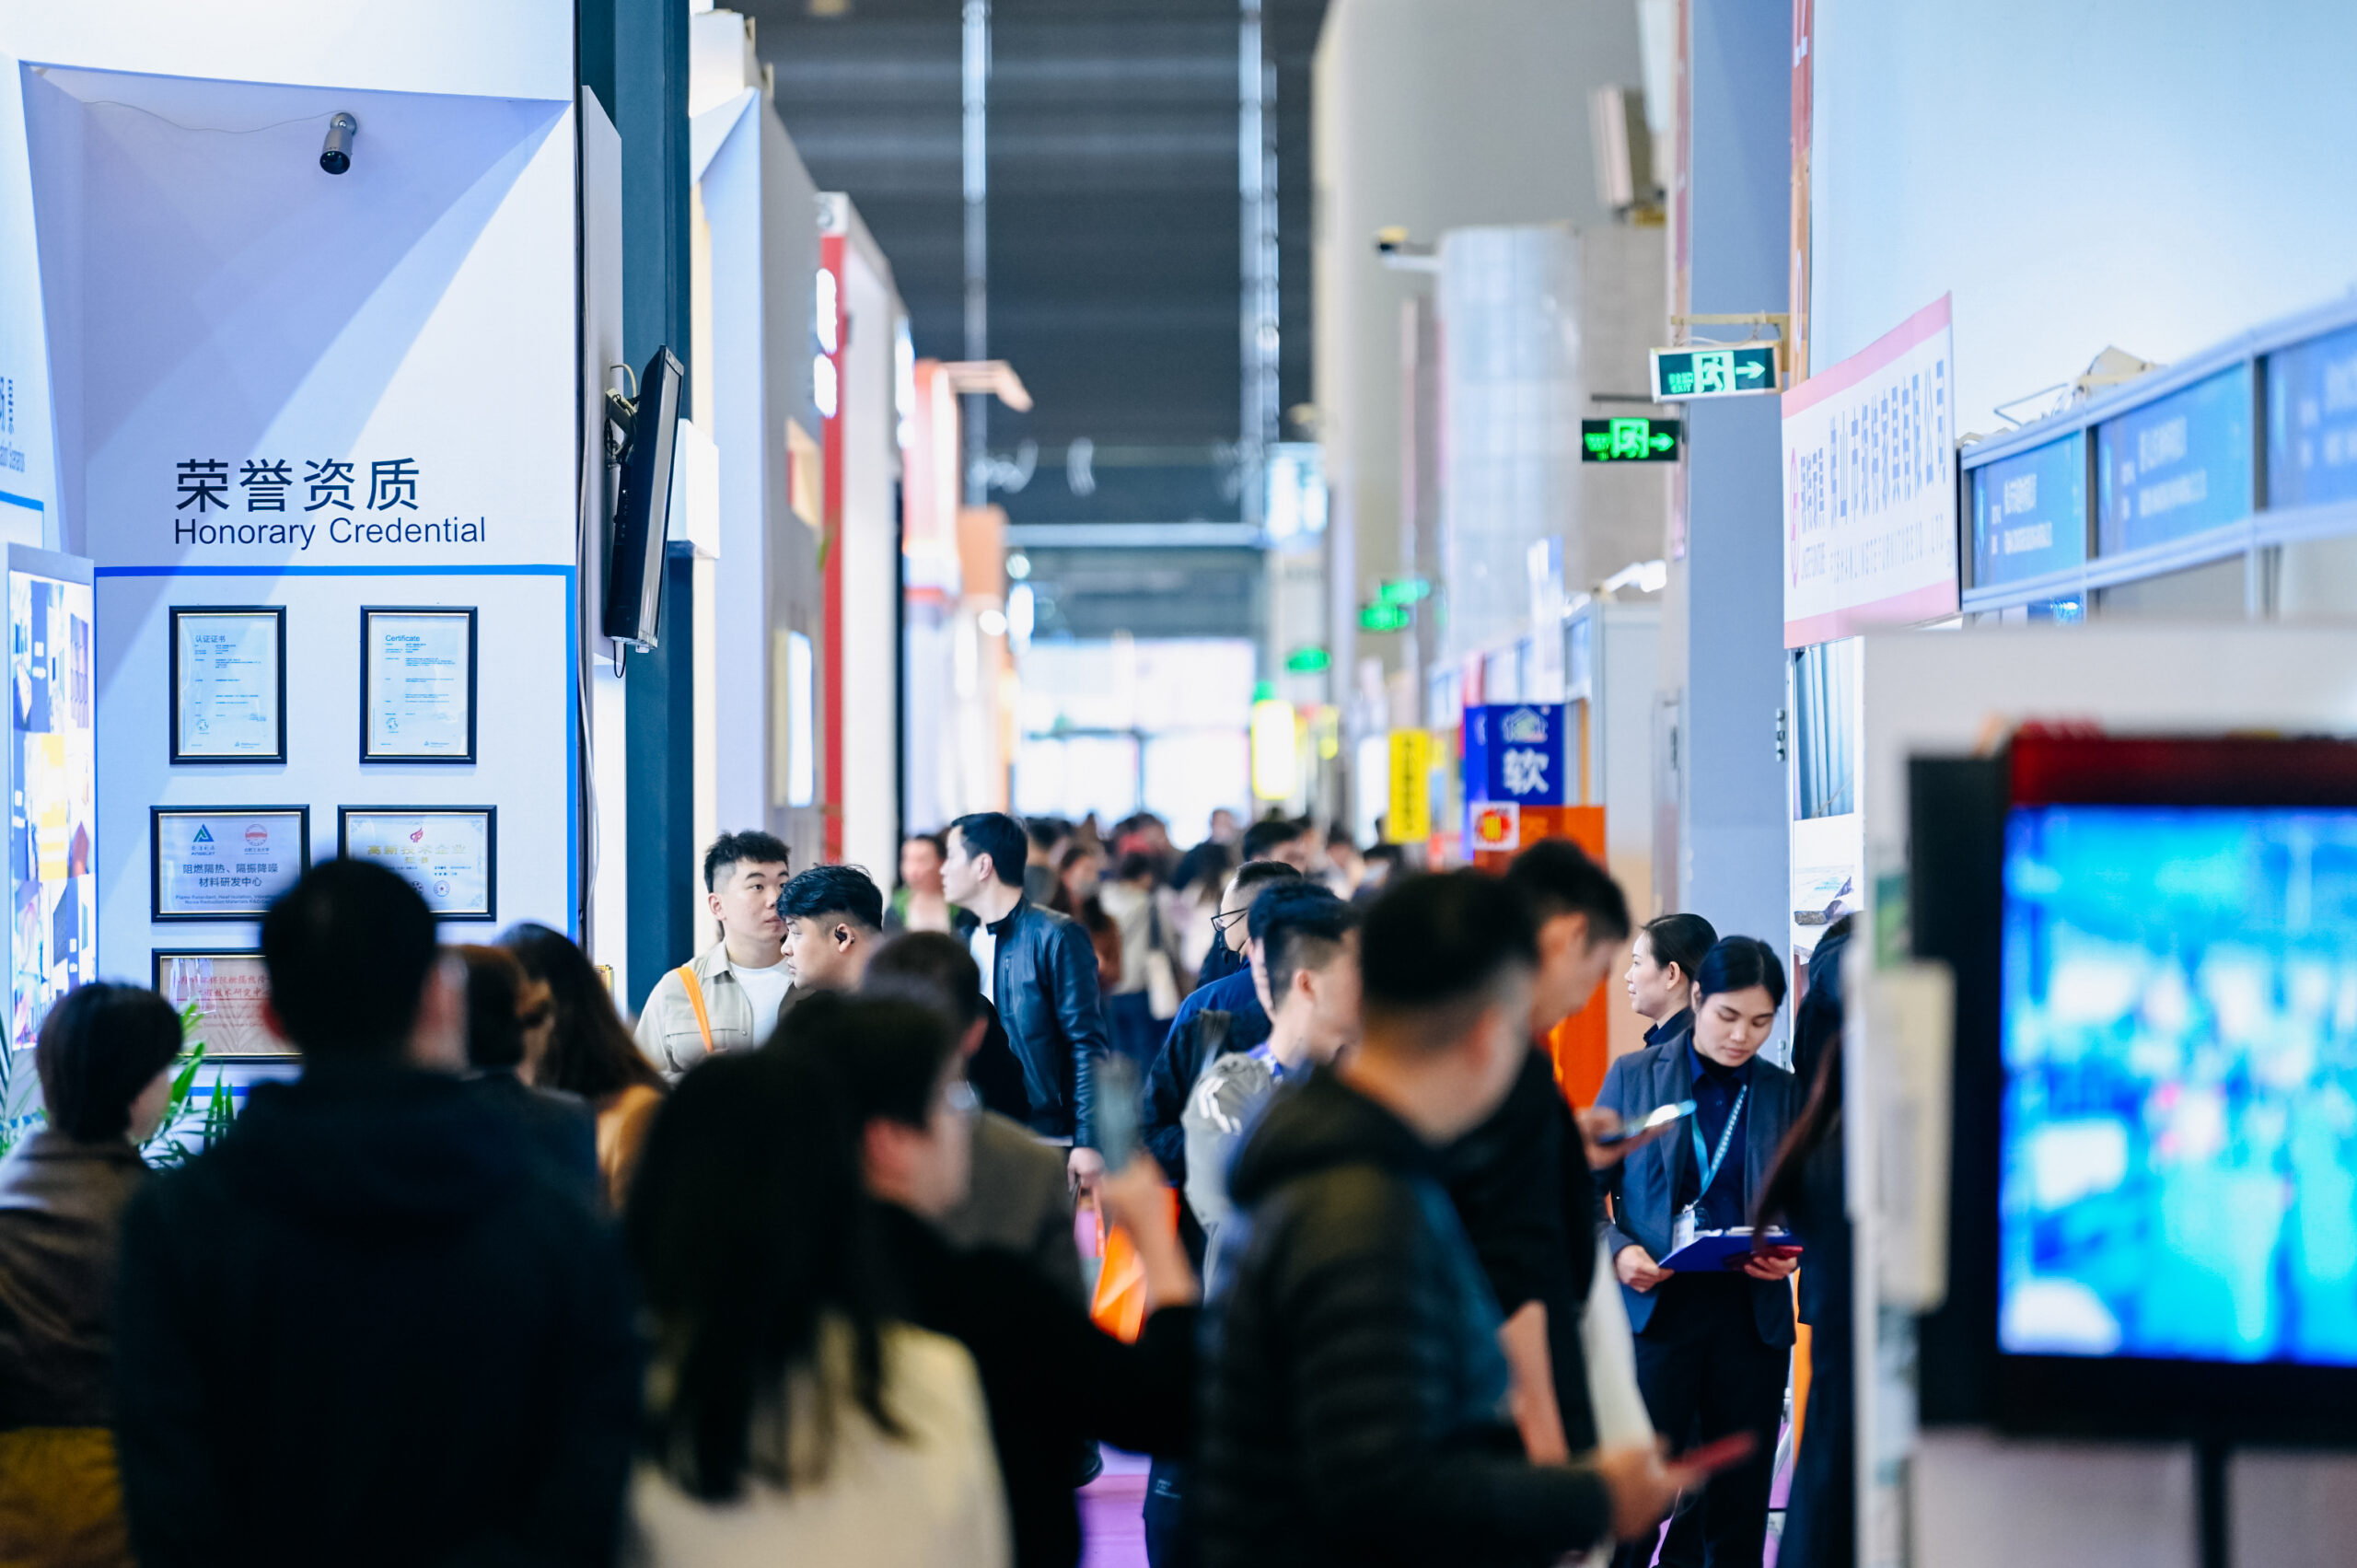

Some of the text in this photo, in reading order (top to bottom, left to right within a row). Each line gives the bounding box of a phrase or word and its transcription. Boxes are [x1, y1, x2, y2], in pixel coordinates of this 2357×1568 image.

[175, 458, 420, 513] 荣誉资质
[175, 517, 485, 550] Honorary Credential
[195, 634, 226, 643] 认证证书
[385, 633, 421, 642] Certificate
[1503, 748, 1550, 796] 软
[199, 877, 262, 888] 材料研发中心
